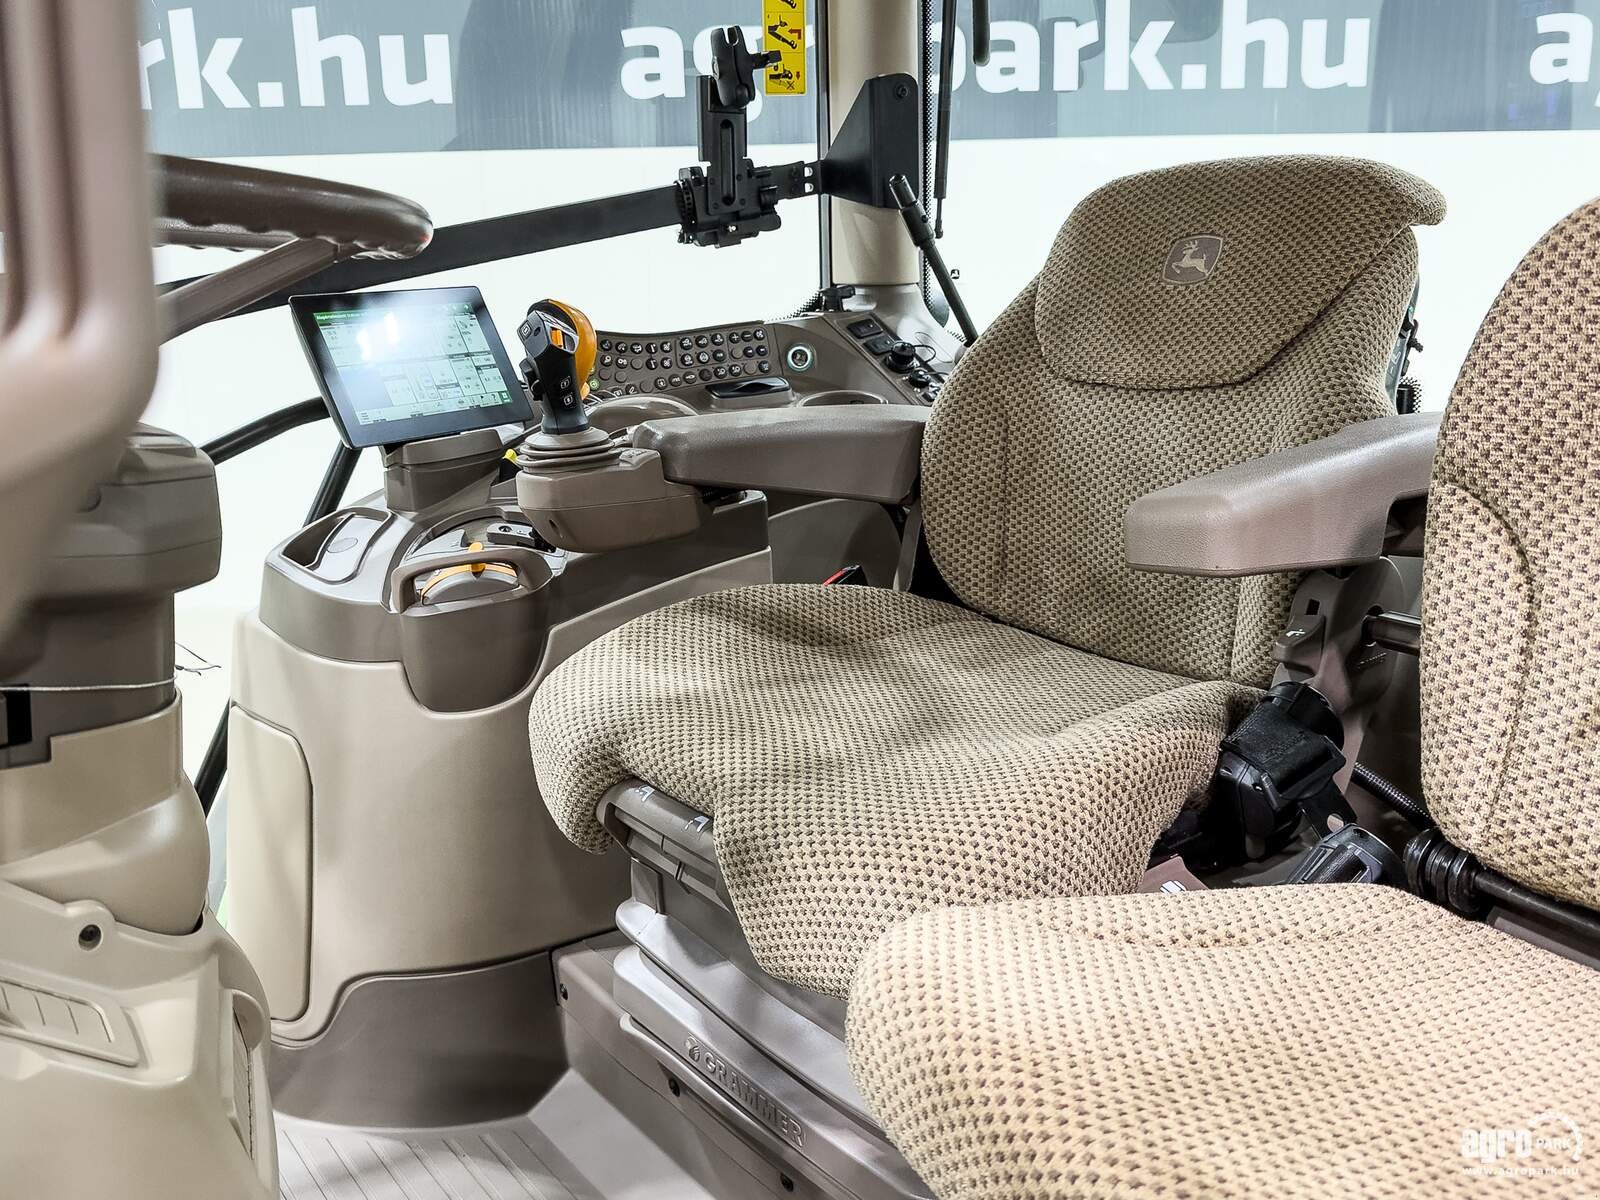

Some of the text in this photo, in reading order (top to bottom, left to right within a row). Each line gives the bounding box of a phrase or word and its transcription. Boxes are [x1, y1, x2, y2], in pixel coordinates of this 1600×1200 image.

[137, 6, 453, 110] rk.hu
[1529, 12, 1600, 108] a
[704, 1051, 803, 1147] GRAMMER
